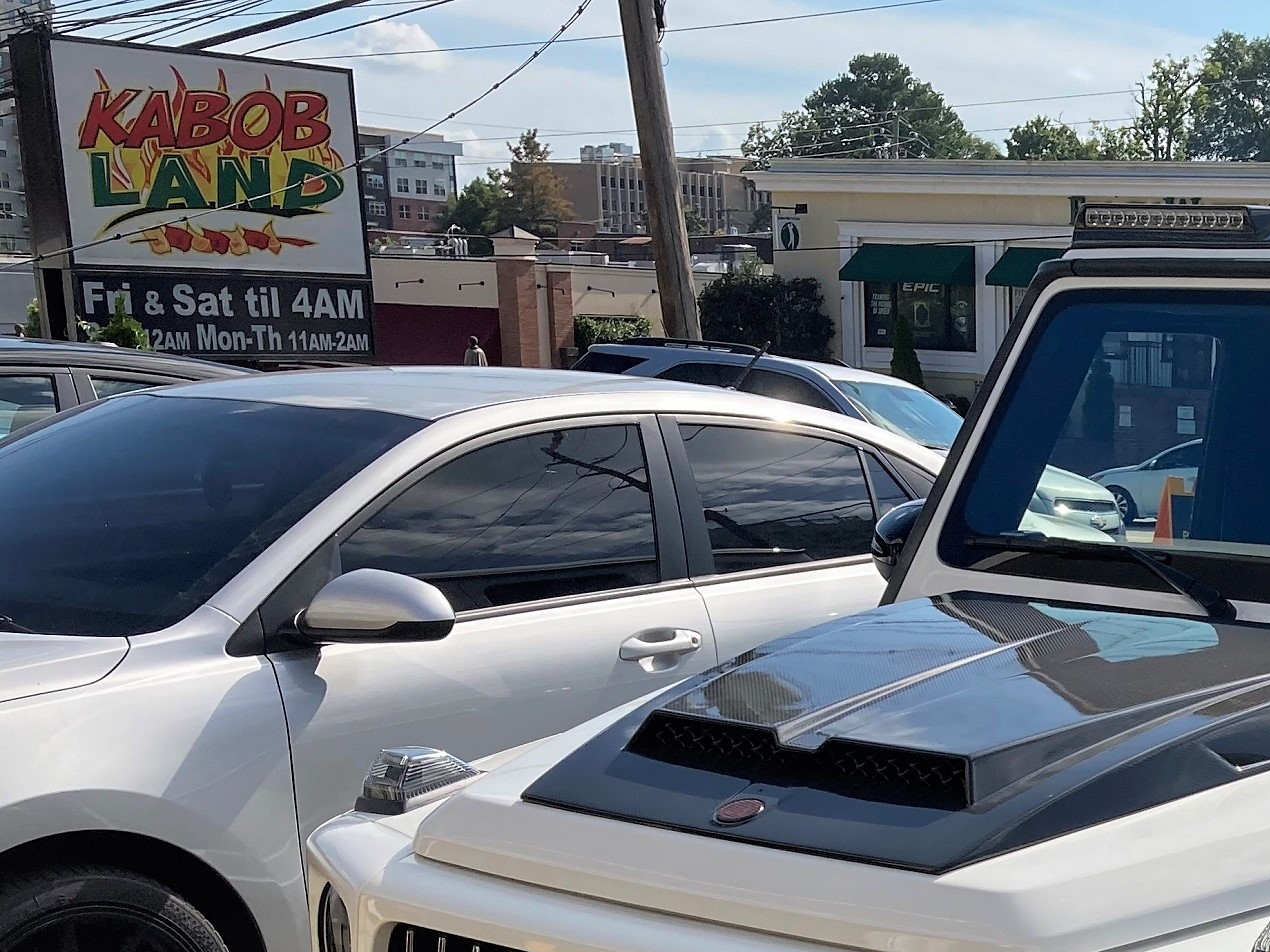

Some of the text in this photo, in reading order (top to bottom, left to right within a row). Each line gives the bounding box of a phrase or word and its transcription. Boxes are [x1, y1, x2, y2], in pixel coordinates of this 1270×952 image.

[79, 89, 331, 150] KABOB
[91, 152, 344, 210] LAND
[83, 281, 364, 319] Fri & Sat til 4AM
[902, 282, 940, 293] EPIC
[197, 324, 282, 351] Mon-Th
[288, 330, 369, 352] 11AM-2AM
